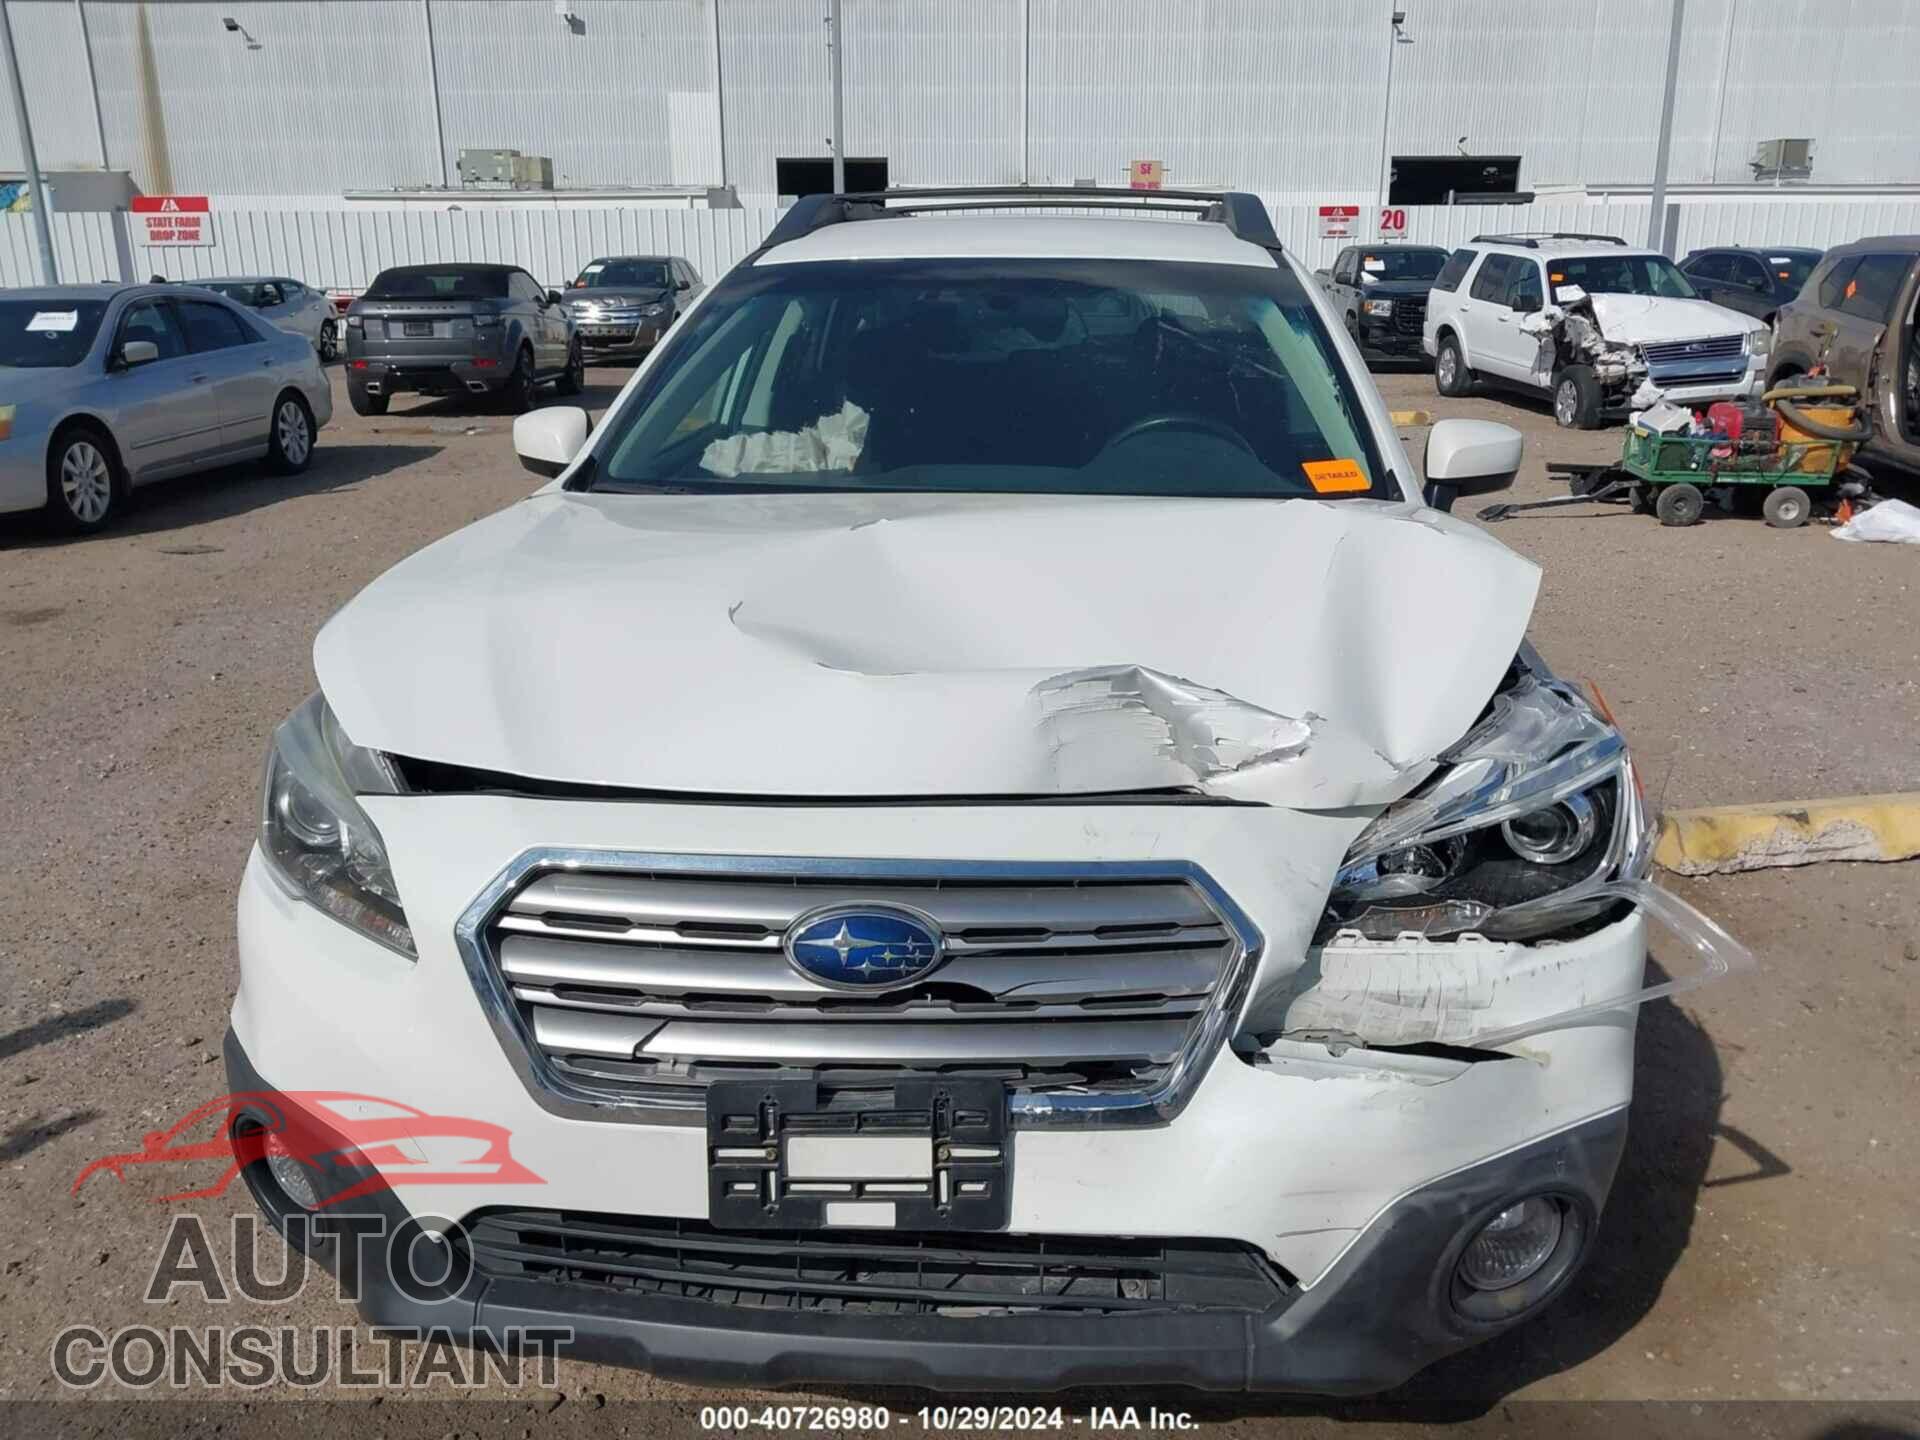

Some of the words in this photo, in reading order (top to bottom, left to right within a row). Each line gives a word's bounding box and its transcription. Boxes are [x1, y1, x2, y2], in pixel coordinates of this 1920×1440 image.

[145, 216, 173, 229] STATE
[175, 216, 201, 228] FARM
[1380, 209, 1406, 230] 20
[150, 230, 175, 241] DROP
[177, 230, 200, 241] ZONE
